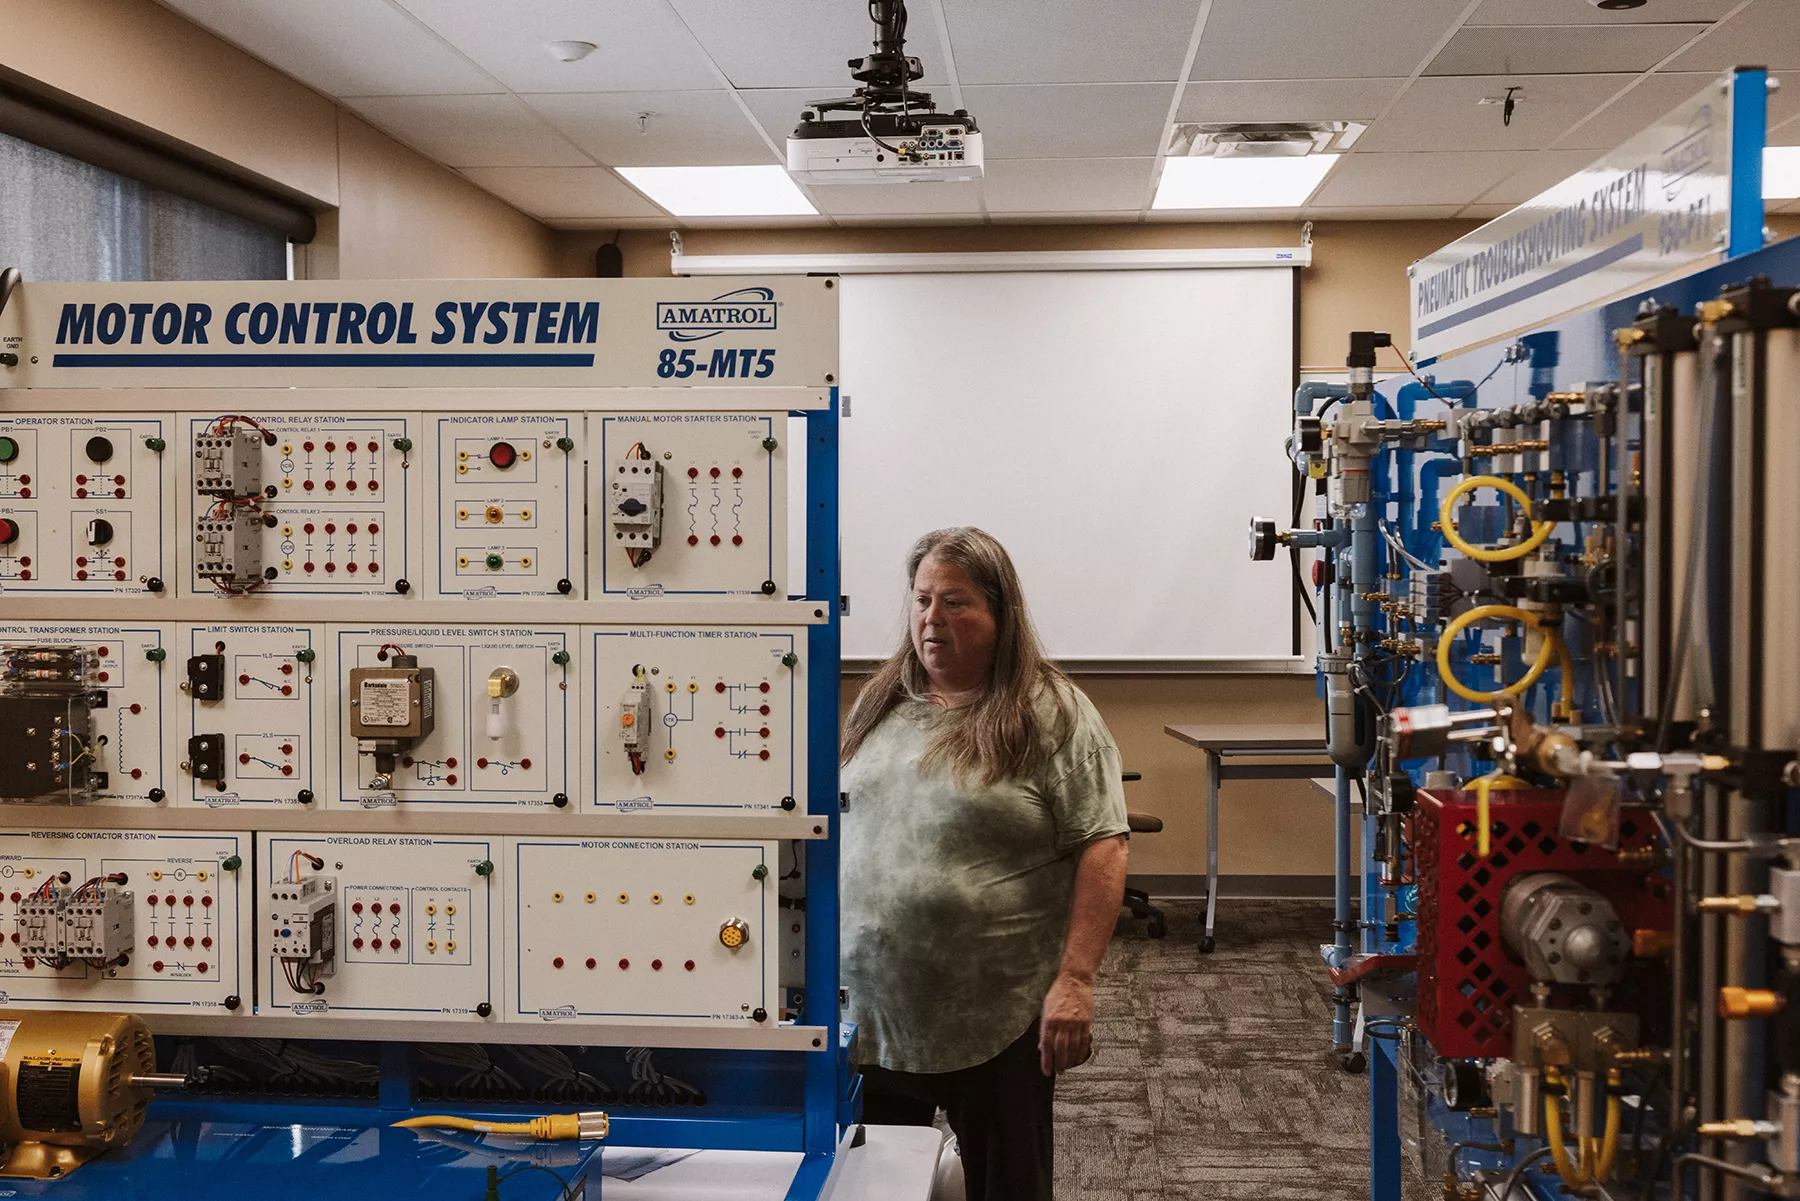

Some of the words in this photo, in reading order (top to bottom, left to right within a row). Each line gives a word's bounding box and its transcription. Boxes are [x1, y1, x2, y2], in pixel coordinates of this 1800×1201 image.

[1418, 257, 1470, 318] PNEUMATIC
[1472, 198, 1586, 294] TROUBLESHOOTING
[1590, 162, 1647, 242] SYSTEM
[662, 308, 772, 324] AMATROL
[55, 302, 213, 345] MOTOR
[224, 302, 419, 345] CONTROL
[431, 301, 600, 345] SYSTEM
[656, 348, 776, 379] 85-MT5
[250, 416, 286, 424] CONTROL
[288, 416, 312, 424] RELAY
[314, 416, 345, 424] STATION
[450, 416, 494, 424] INDICATOR
[371, 628, 440, 636] PRESSURE/LIQUID
[500, 629, 533, 637] STATION
[76, 832, 122, 840] CONTACTOR
[399, 838, 432, 846] STATION
[612, 842, 663, 850] CONNECTION
[665, 842, 699, 850] STATION
